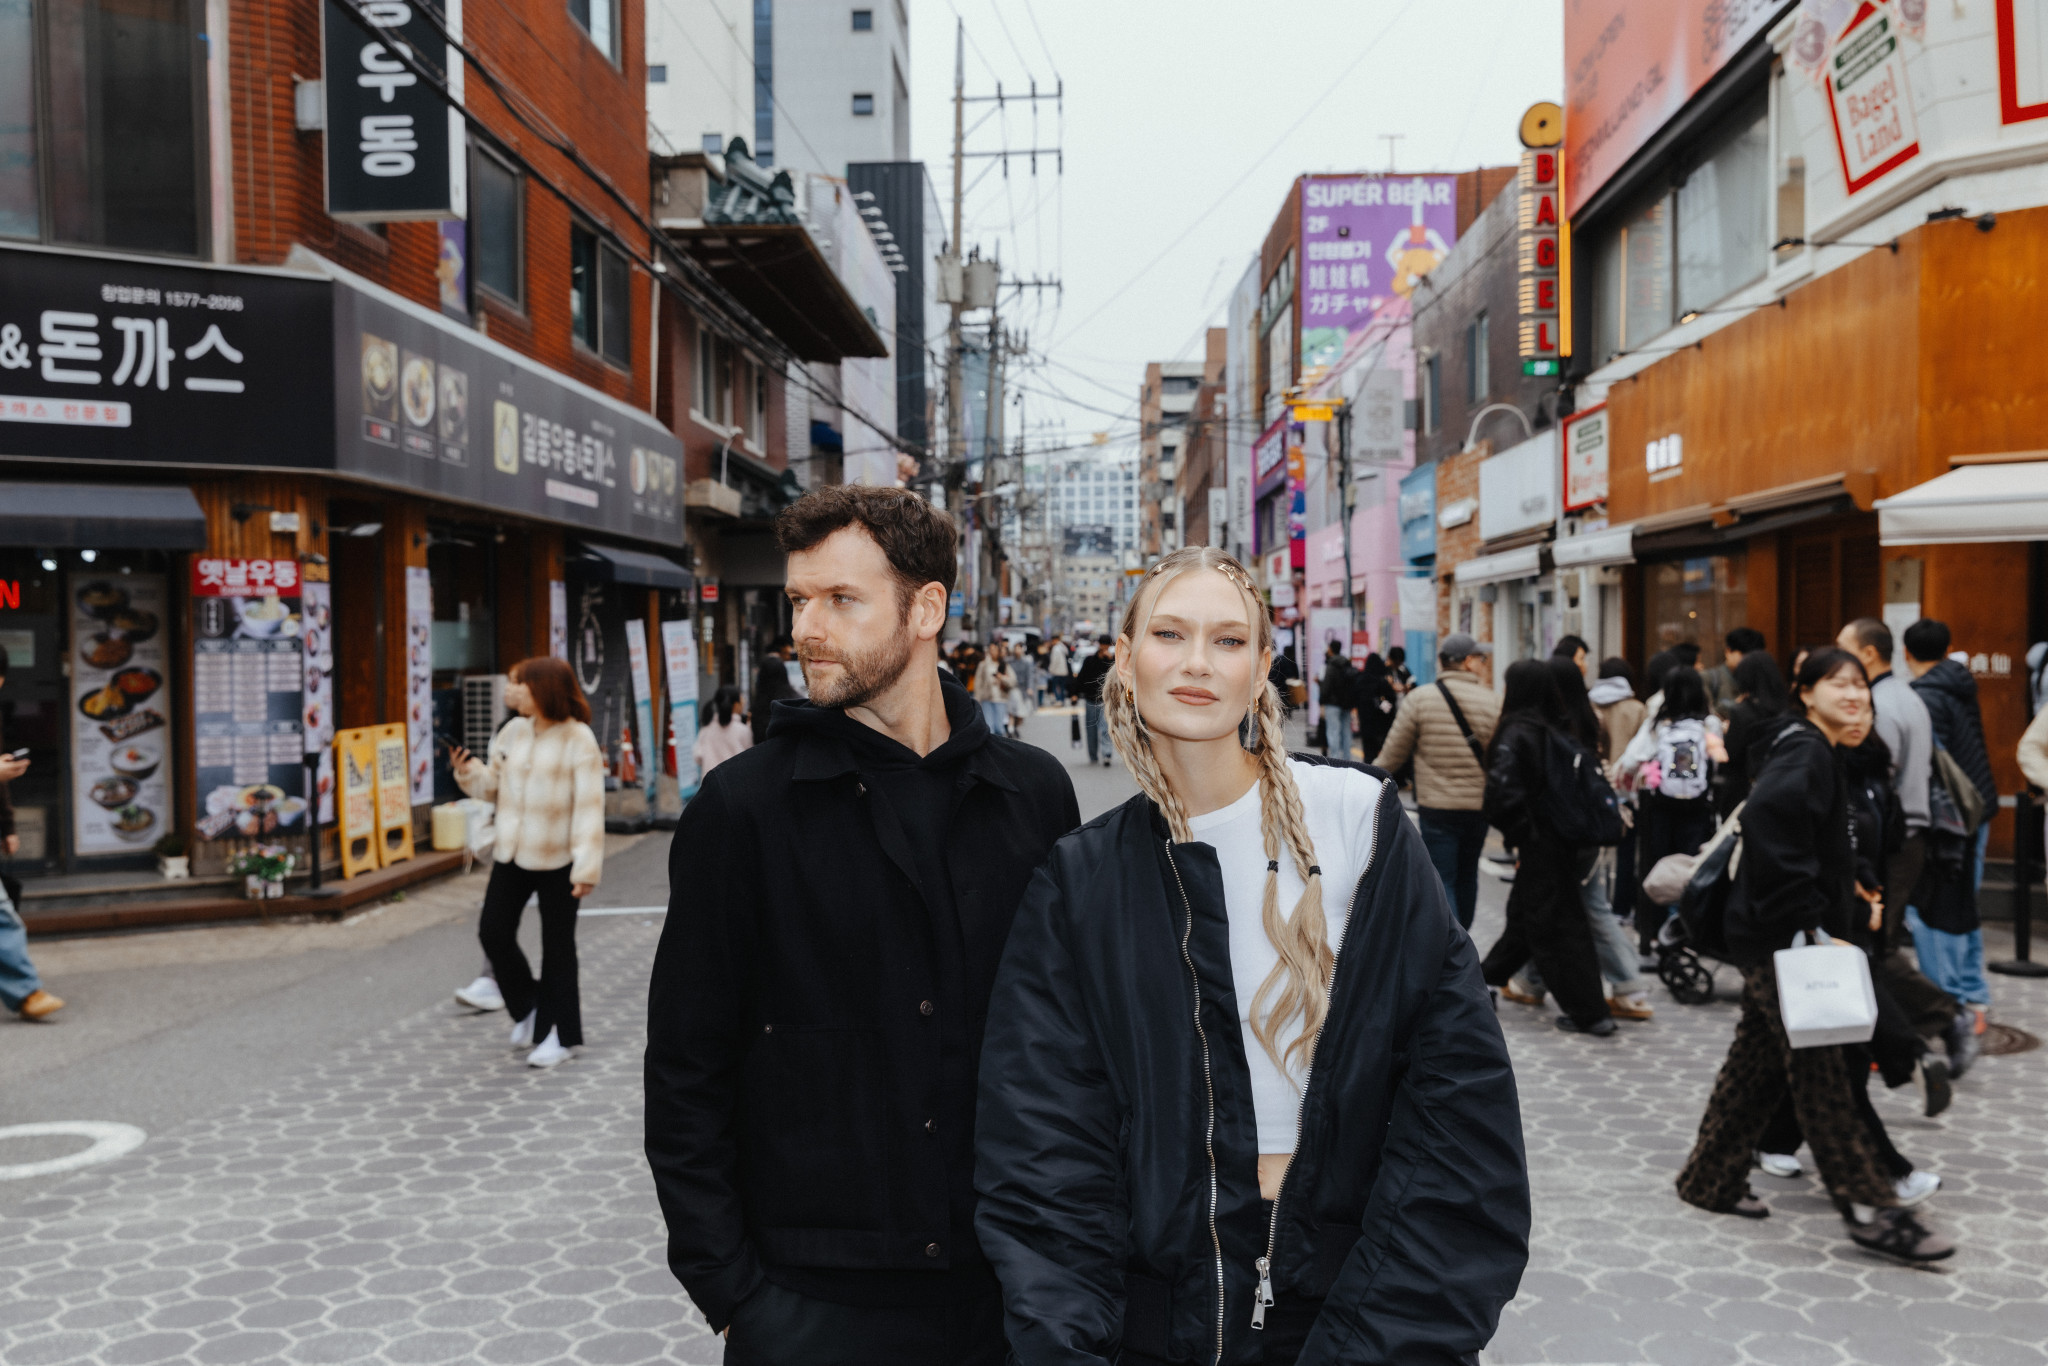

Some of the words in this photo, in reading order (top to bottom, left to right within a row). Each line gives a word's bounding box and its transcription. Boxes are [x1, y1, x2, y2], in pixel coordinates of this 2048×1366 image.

[1306, 184, 1383, 208] SUPER
[1387, 181, 1451, 207] BEAR
[1307, 215, 1330, 234] 2F
[1535, 153, 1556, 351] BAGEL
[197, 558, 298, 588] 옛날우동
